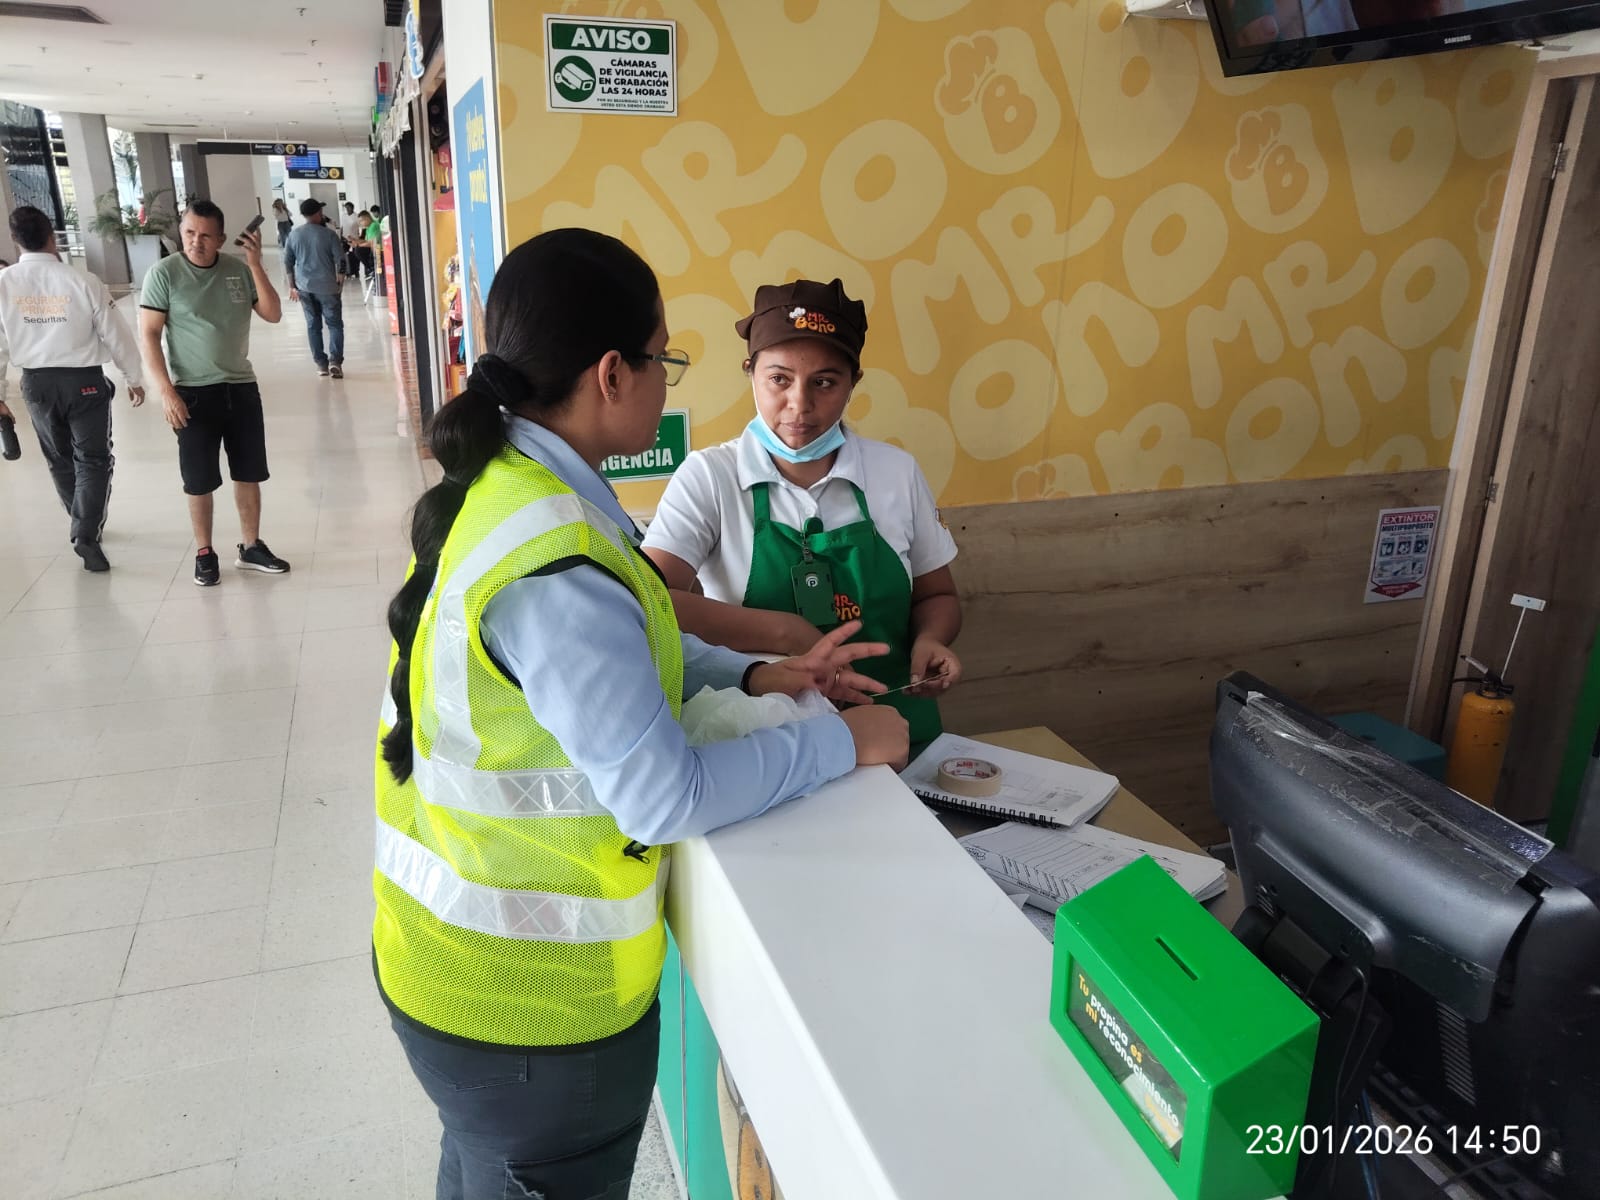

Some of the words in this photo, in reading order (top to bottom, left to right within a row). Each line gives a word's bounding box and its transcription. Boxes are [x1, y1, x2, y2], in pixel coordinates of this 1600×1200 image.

[571, 27, 652, 51] AVISO
[1443, 34, 1472, 44] SAMSUNG
[610, 57, 657, 69] CÁMARAS
[600, 68, 612, 76] DE
[615, 69, 668, 78] VIGILANCIA
[599, 77, 611, 85] EN
[614, 77, 669, 88] GRABACIÓN
[601, 87, 619, 95] LAS
[622, 87, 633, 96] 24
[635, 88, 668, 97] HORAS
[23, 316, 68, 324] Securitas
[1383, 513, 1435, 524] EXTINTOR
[1078, 974, 1089, 997] Tu
[1090, 994, 1129, 1047] propina
[1130, 1044, 1143, 1063] es
[1085, 1002, 1098, 1023] mi
[1099, 1020, 1179, 1128] reconocimiento
